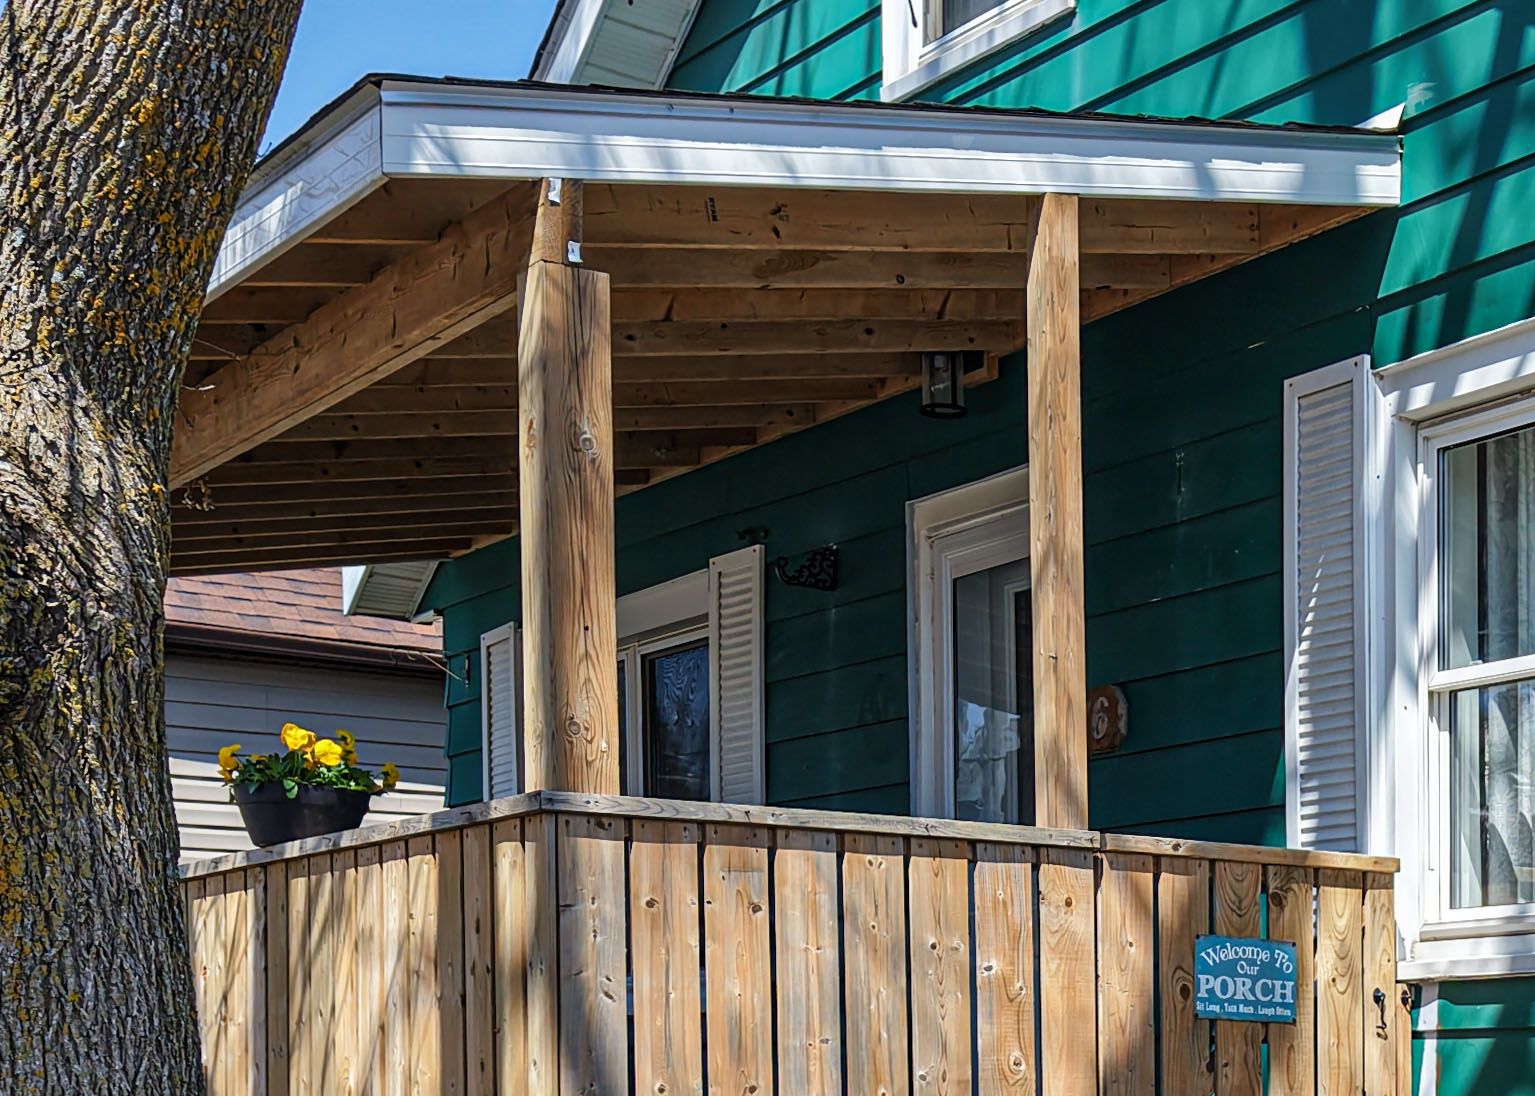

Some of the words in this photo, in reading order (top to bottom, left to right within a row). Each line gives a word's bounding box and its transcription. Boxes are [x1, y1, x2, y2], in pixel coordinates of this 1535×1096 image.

[1201, 943, 1270, 966] Welcome
[1275, 950, 1293, 974] To
[1237, 961, 1259, 975] Our
[1197, 974, 1295, 1003] PORCH
